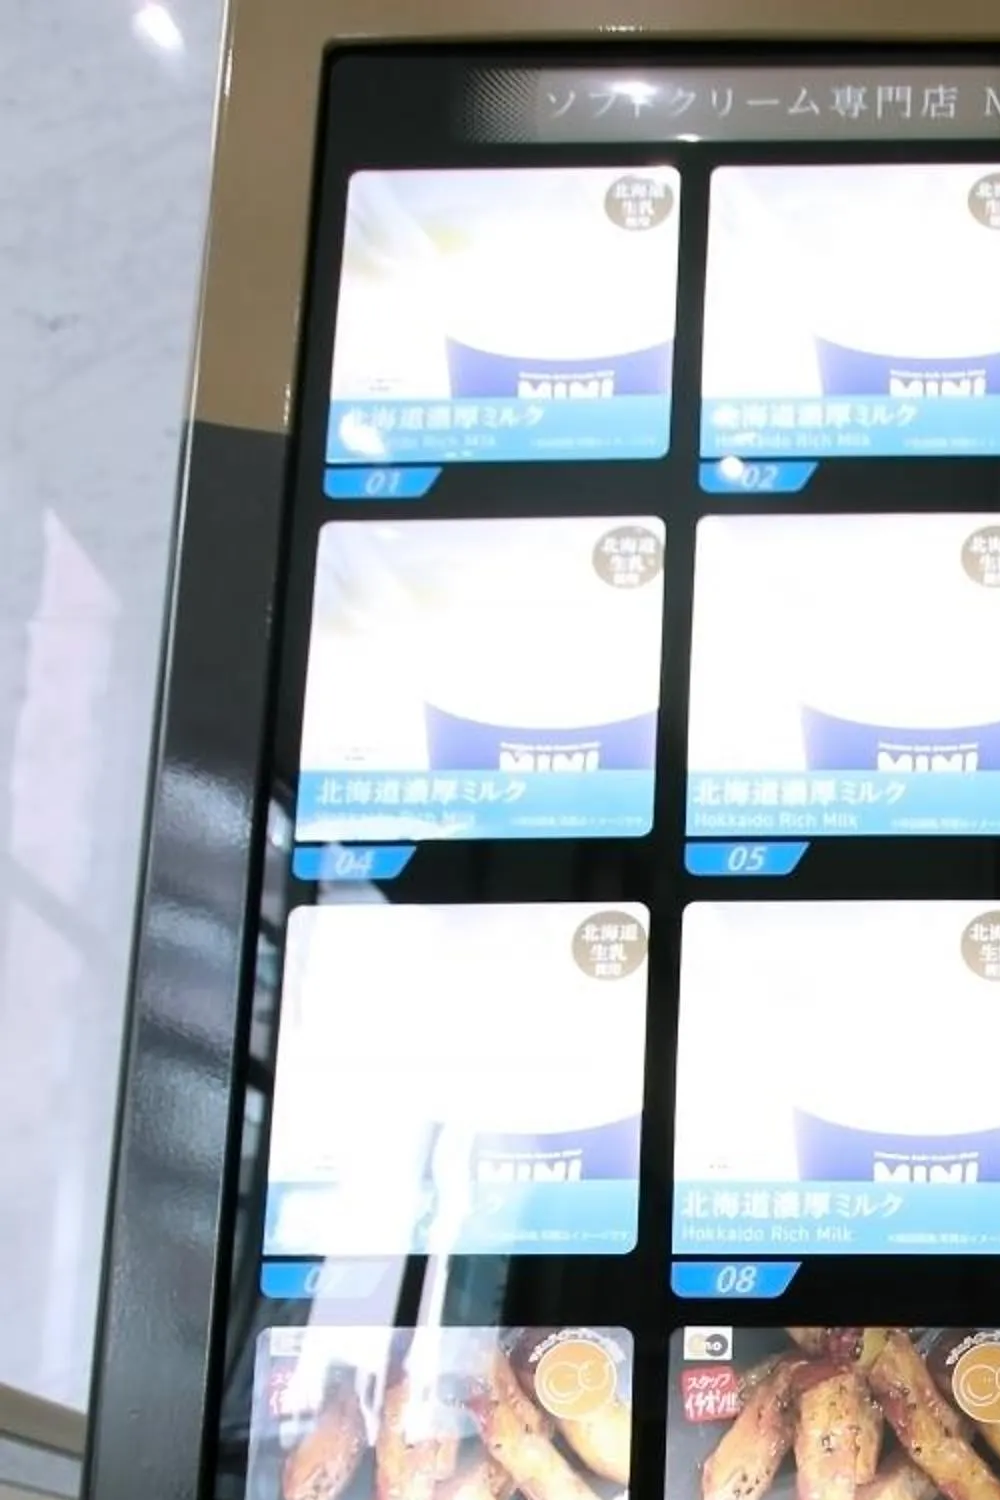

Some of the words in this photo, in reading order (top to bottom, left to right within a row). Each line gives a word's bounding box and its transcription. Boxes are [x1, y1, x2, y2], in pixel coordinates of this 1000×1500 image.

[547, 86, 958, 119] ソフトクリーム専門店
[365, 471, 399, 496] 01
[741, 464, 778, 489] 02
[316, 777, 526, 806] 北海道濃厚ミルク
[693, 779, 905, 806] 北海道濃厚ミルク
[728, 846, 765, 872] 05
[682, 1191, 903, 1220] 北海道濃厚ミルク
[771, 1223, 809, 1242] Rich
[816, 1223, 854, 1242] Milk
[717, 1265, 758, 1293] 08
